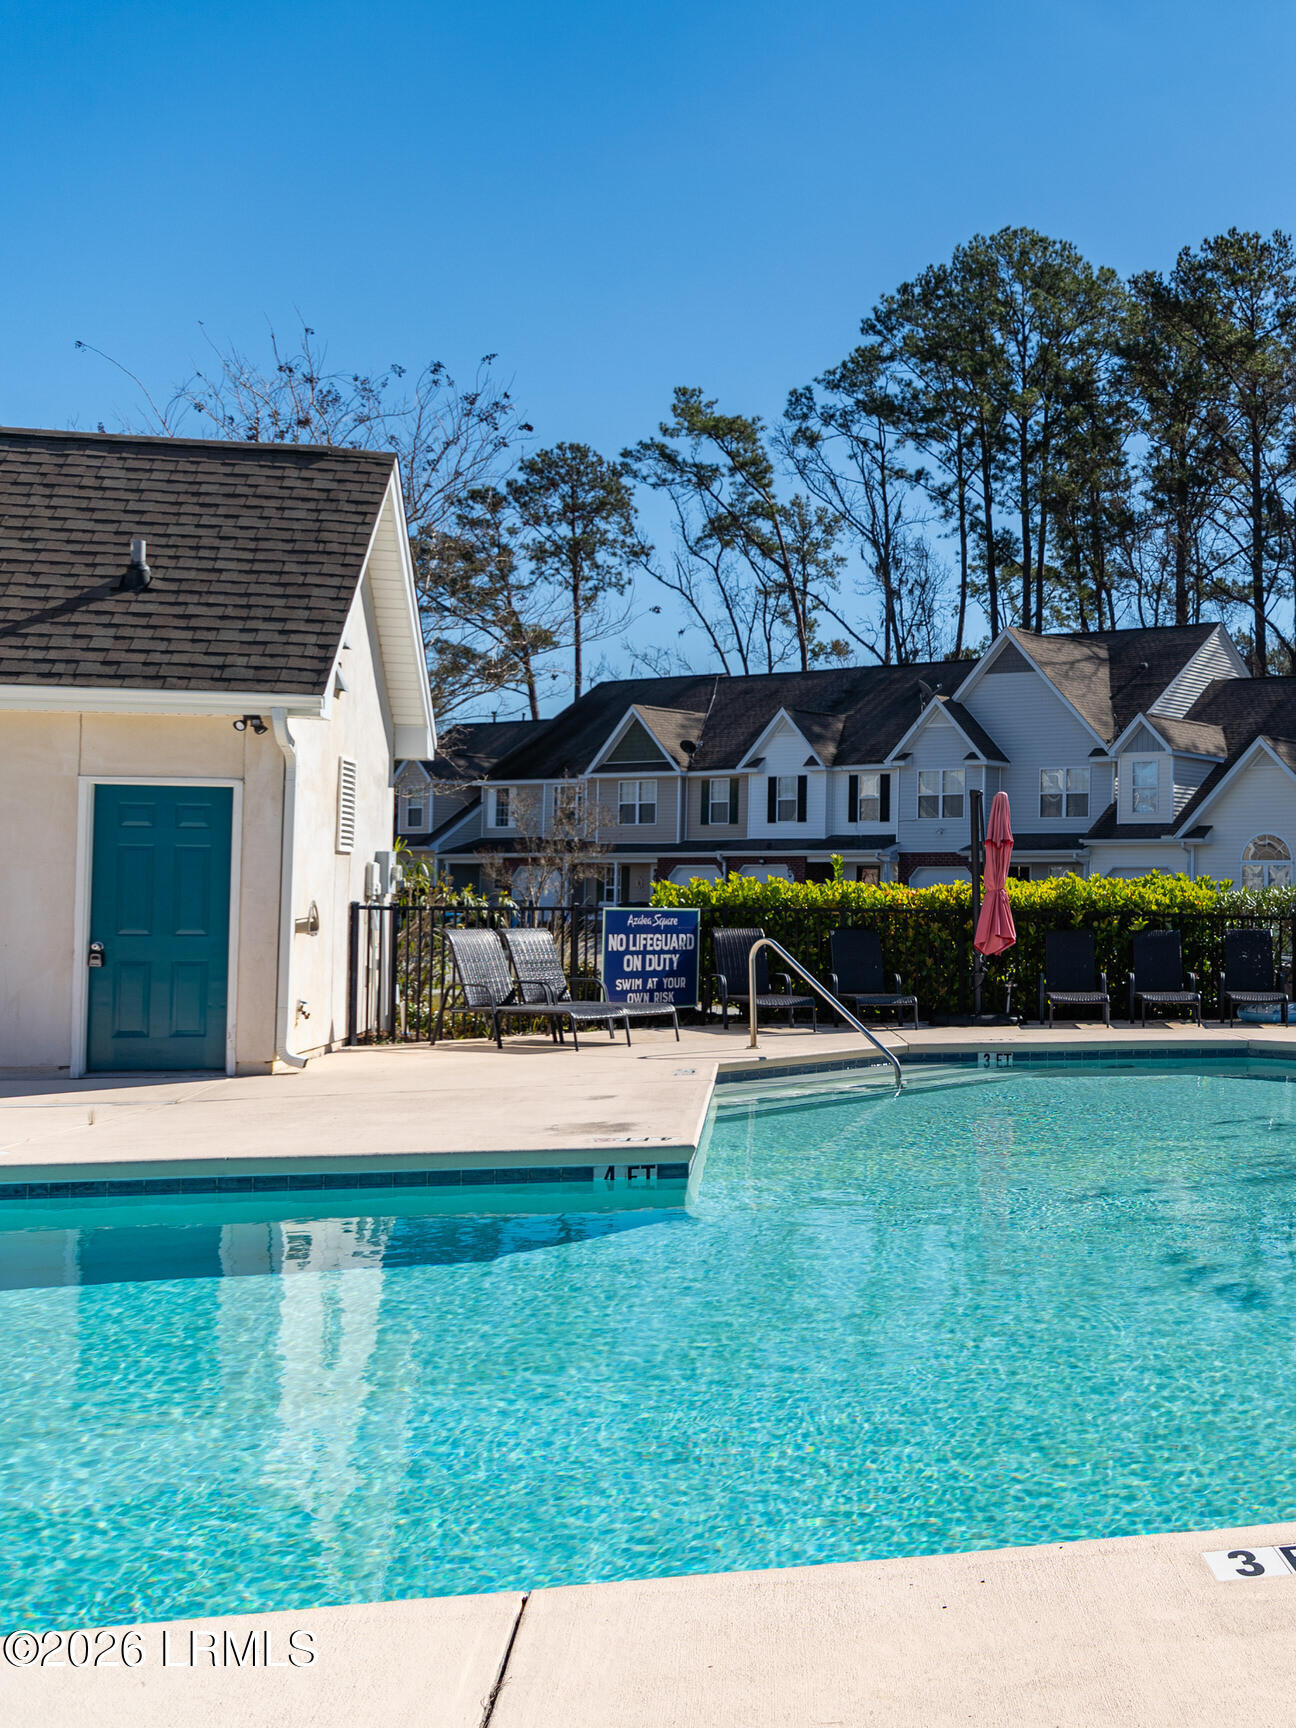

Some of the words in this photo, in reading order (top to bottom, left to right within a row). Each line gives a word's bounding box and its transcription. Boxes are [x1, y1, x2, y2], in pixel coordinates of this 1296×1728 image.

[652, 914, 679, 930] Square
[608, 934, 627, 951] NO
[629, 933, 695, 951] LIFEGUARD
[623, 954, 643, 972] ON
[645, 953, 680, 971] DUTY
[615, 978, 643, 991] SWIM
[646, 978, 658, 990] AT
[662, 977, 686, 989] YOUR
[626, 992, 650, 1003] OWN
[653, 992, 675, 1003] RISK
[604, 1165, 615, 1181] 4
[627, 1164, 656, 1180] FT
[1227, 1550, 1265, 1576] 3
